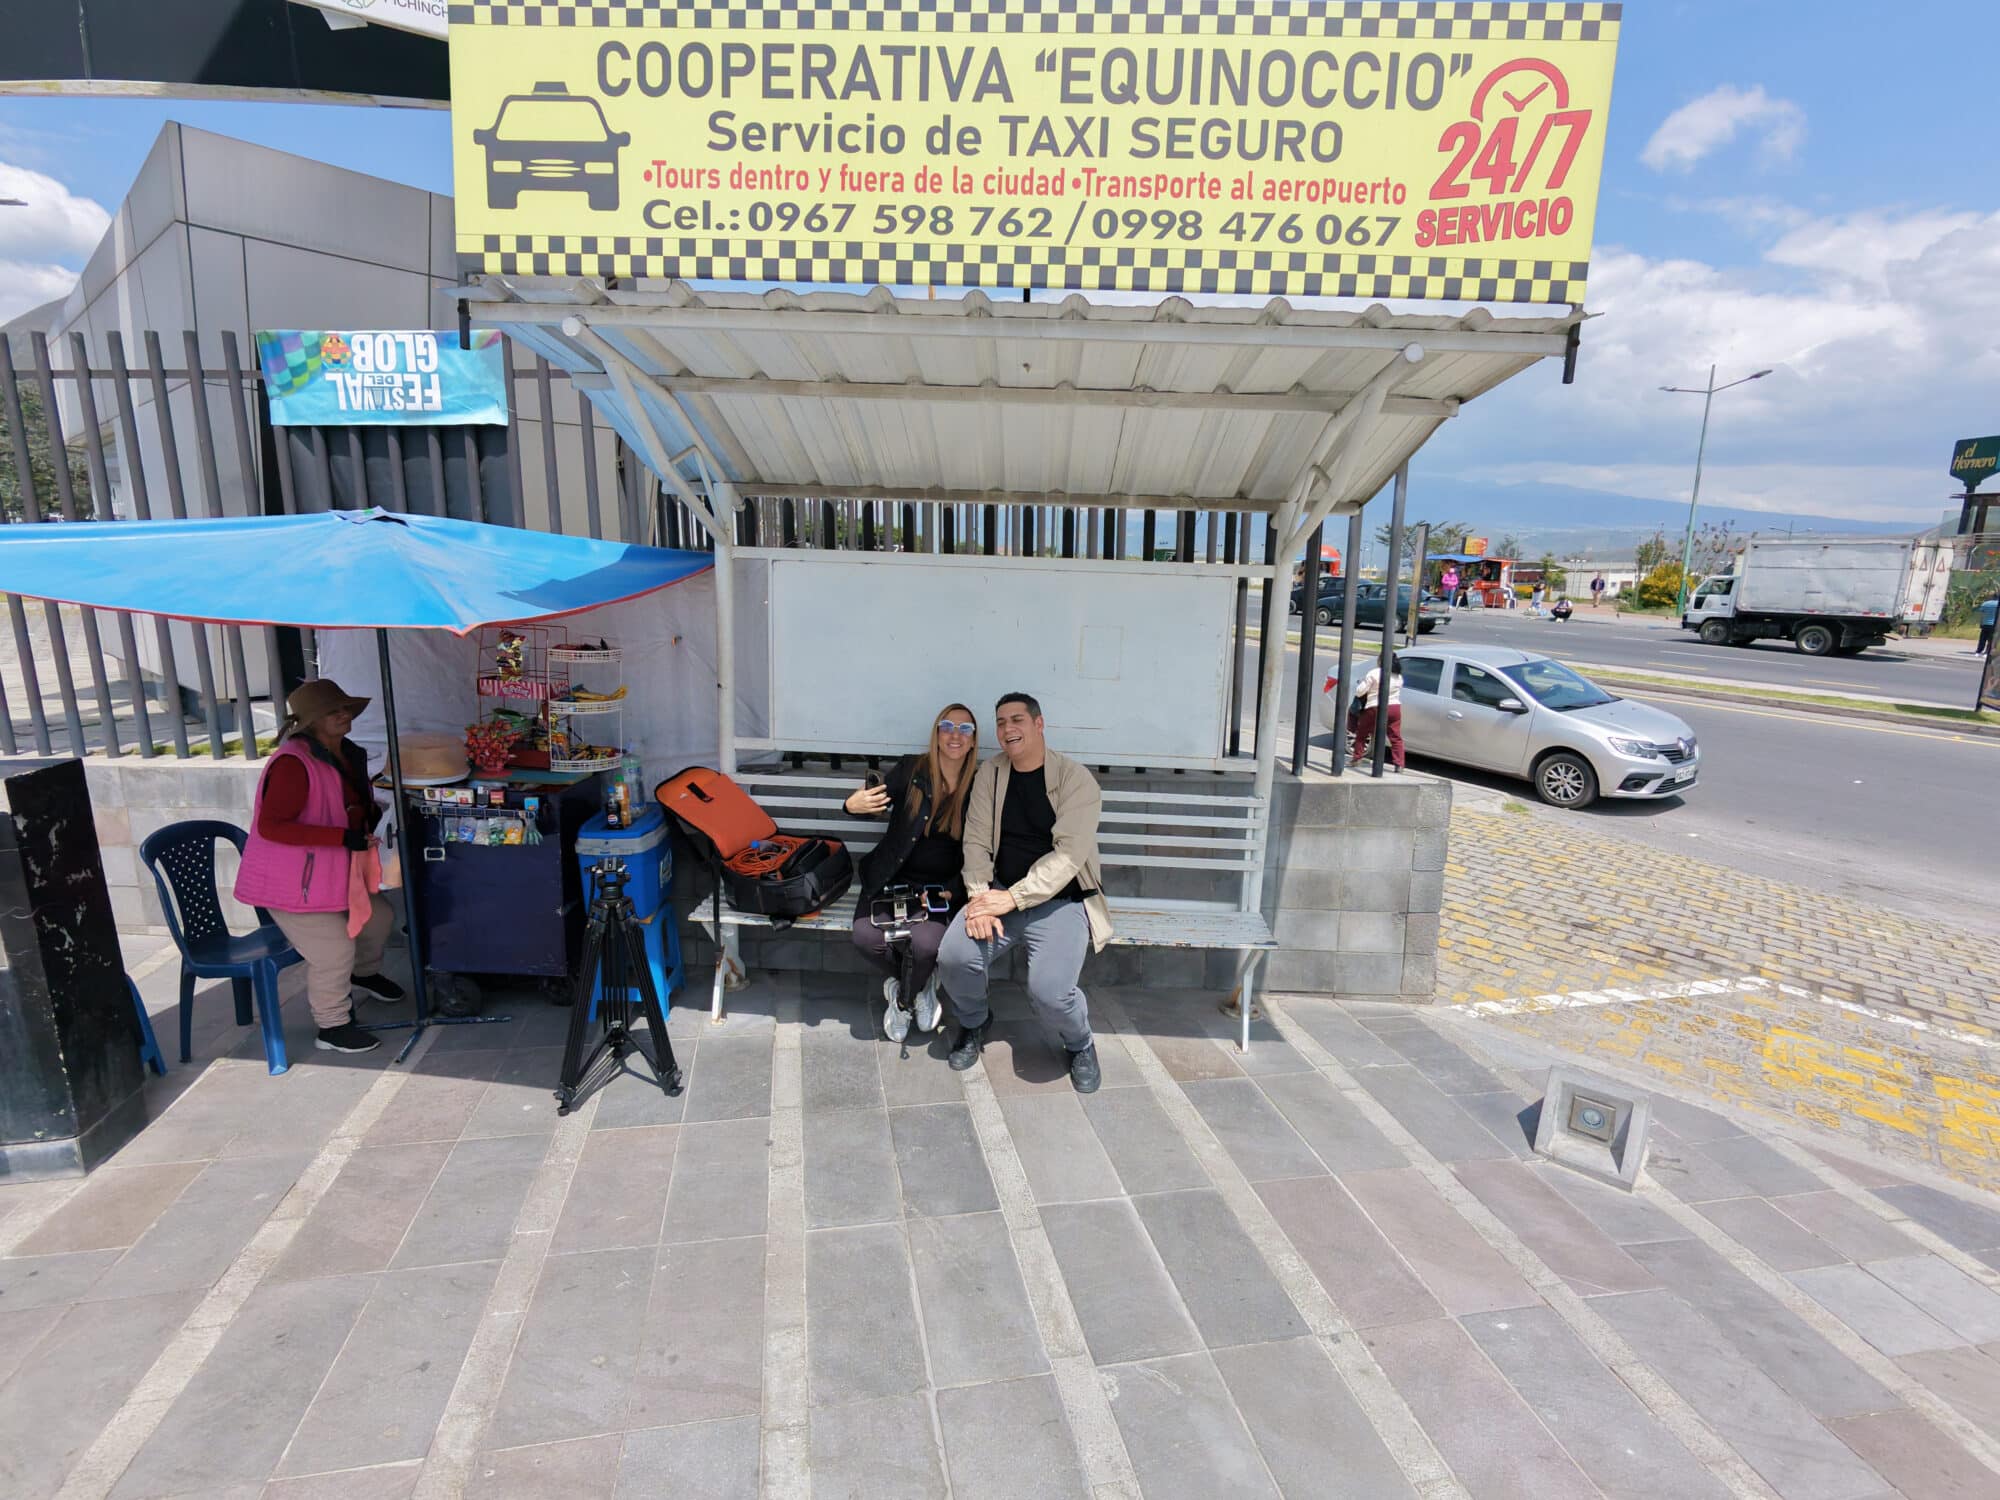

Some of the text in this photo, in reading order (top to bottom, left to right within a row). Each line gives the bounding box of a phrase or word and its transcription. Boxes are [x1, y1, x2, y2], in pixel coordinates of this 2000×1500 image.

[597, 41, 1473, 112] COOPERATIVA “EQUINOCCIO”
[706, 110, 1343, 163] Servicio de TAXI SEGURO
[1428, 110, 1592, 201] 24/7
[729, 161, 809, 193] dentro
[818, 167, 832, 193] y
[839, 163, 905, 195] fuera
[914, 164, 943, 194] de
[952, 165, 975, 195] la
[983, 167, 1065, 197] ciudad
[1230, 170, 1254, 201] al
[1262, 176, 1407, 206] aeropuerto
[872, 204, 954, 236] 598
[1219, 211, 1304, 244] 476
[1315, 214, 1401, 247] 067
[1415, 197, 1574, 248] SERVICIO
[369, 375, 395, 386] DEL
